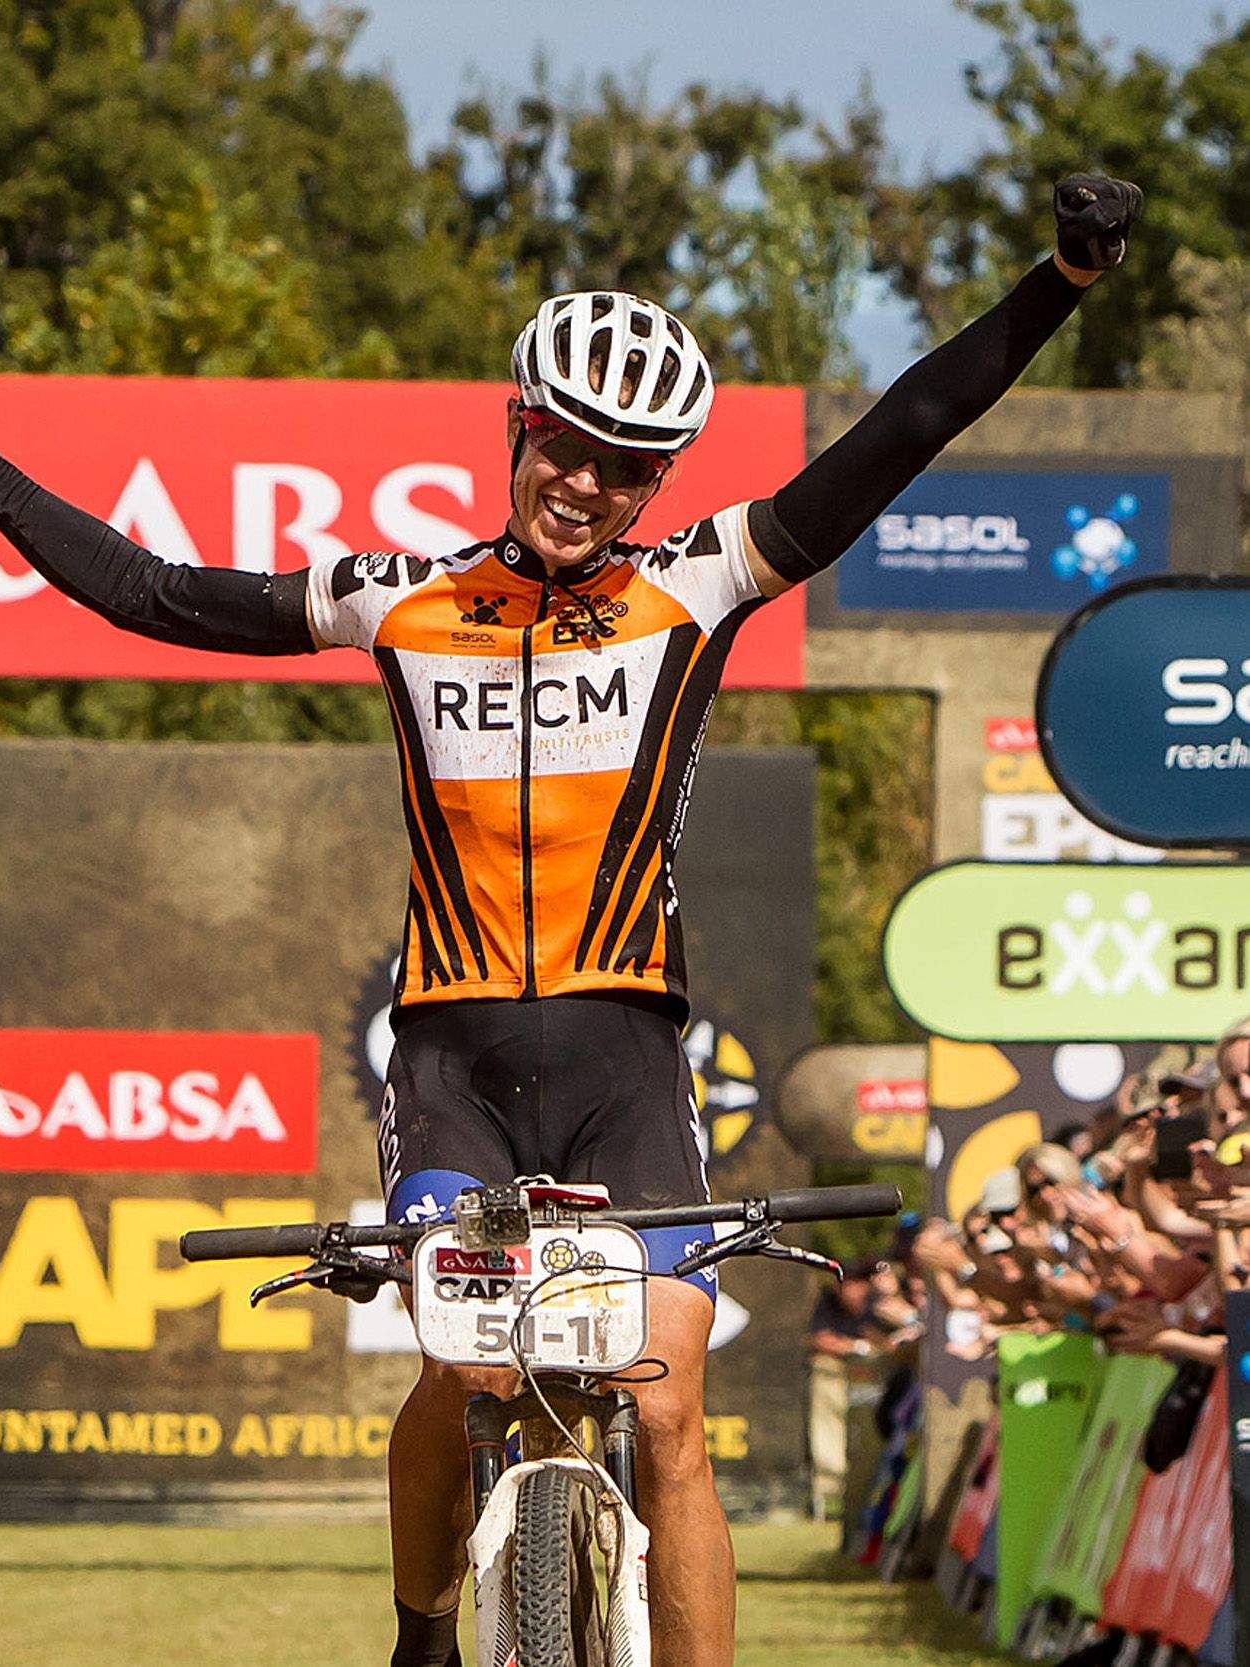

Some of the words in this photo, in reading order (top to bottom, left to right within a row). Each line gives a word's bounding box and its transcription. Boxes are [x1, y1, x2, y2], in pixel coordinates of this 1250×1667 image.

[105, 456, 486, 577] ABS
[433, 666, 629, 731] RECM
[572, 728, 631, 748] TRUSTS
[41, 1070, 288, 1142] ABSA
[433, 1276, 531, 1305] CAPE
[473, 1313, 590, 1356] 51-1
[230, 1411, 392, 1459] AFRIC
